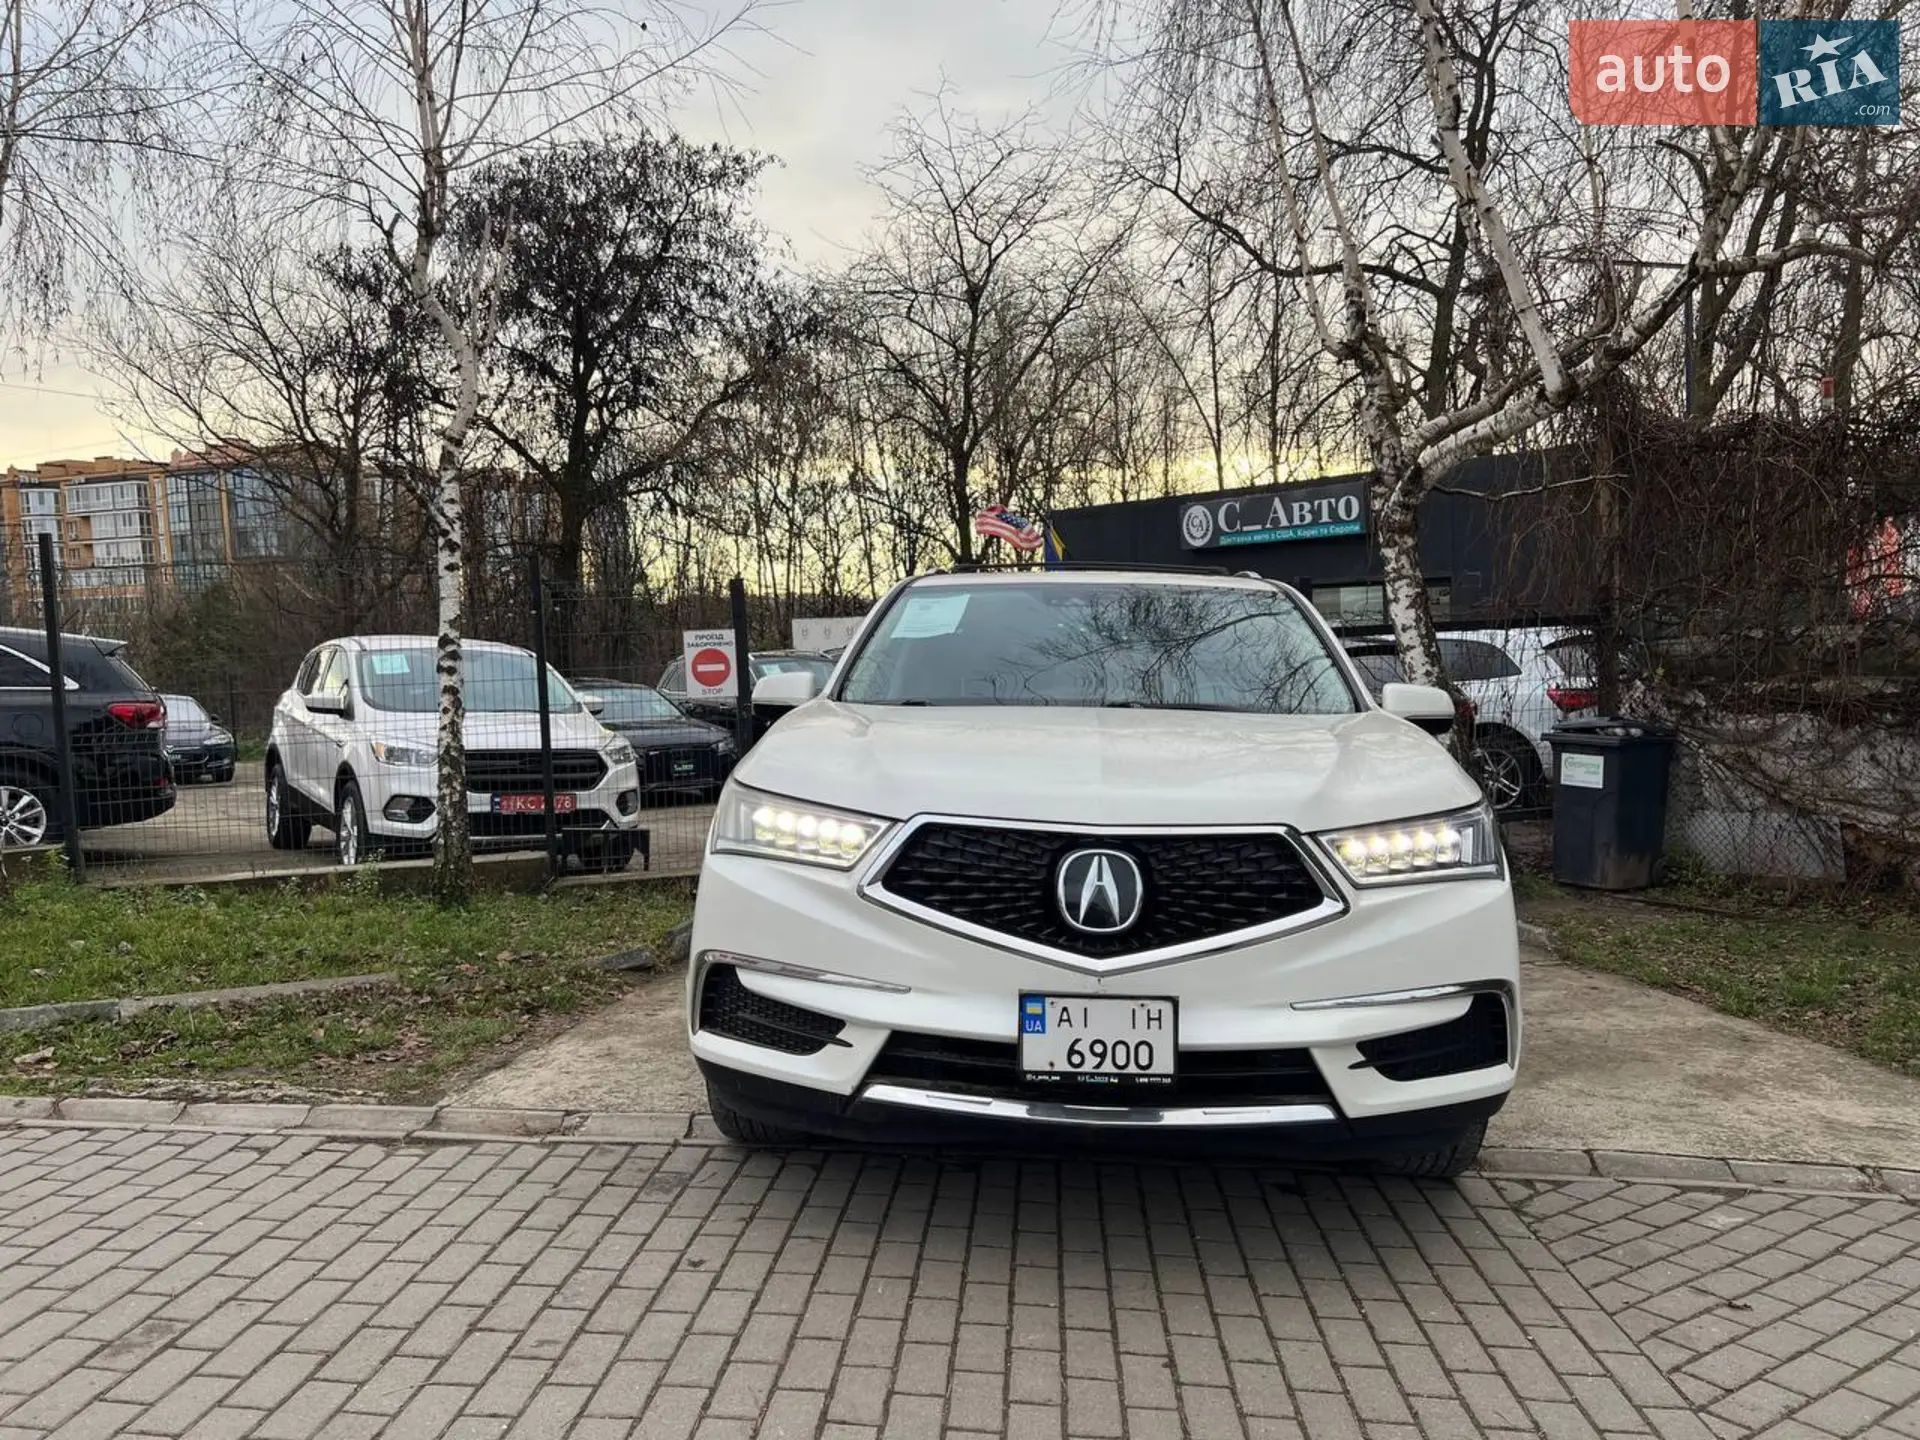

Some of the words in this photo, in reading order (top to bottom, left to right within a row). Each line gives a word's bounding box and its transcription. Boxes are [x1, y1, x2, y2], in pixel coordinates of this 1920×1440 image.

[701, 688, 724, 696] STOP
[1025, 1020, 1043, 1032] UA
[1066, 1038, 1154, 1071] 6900
